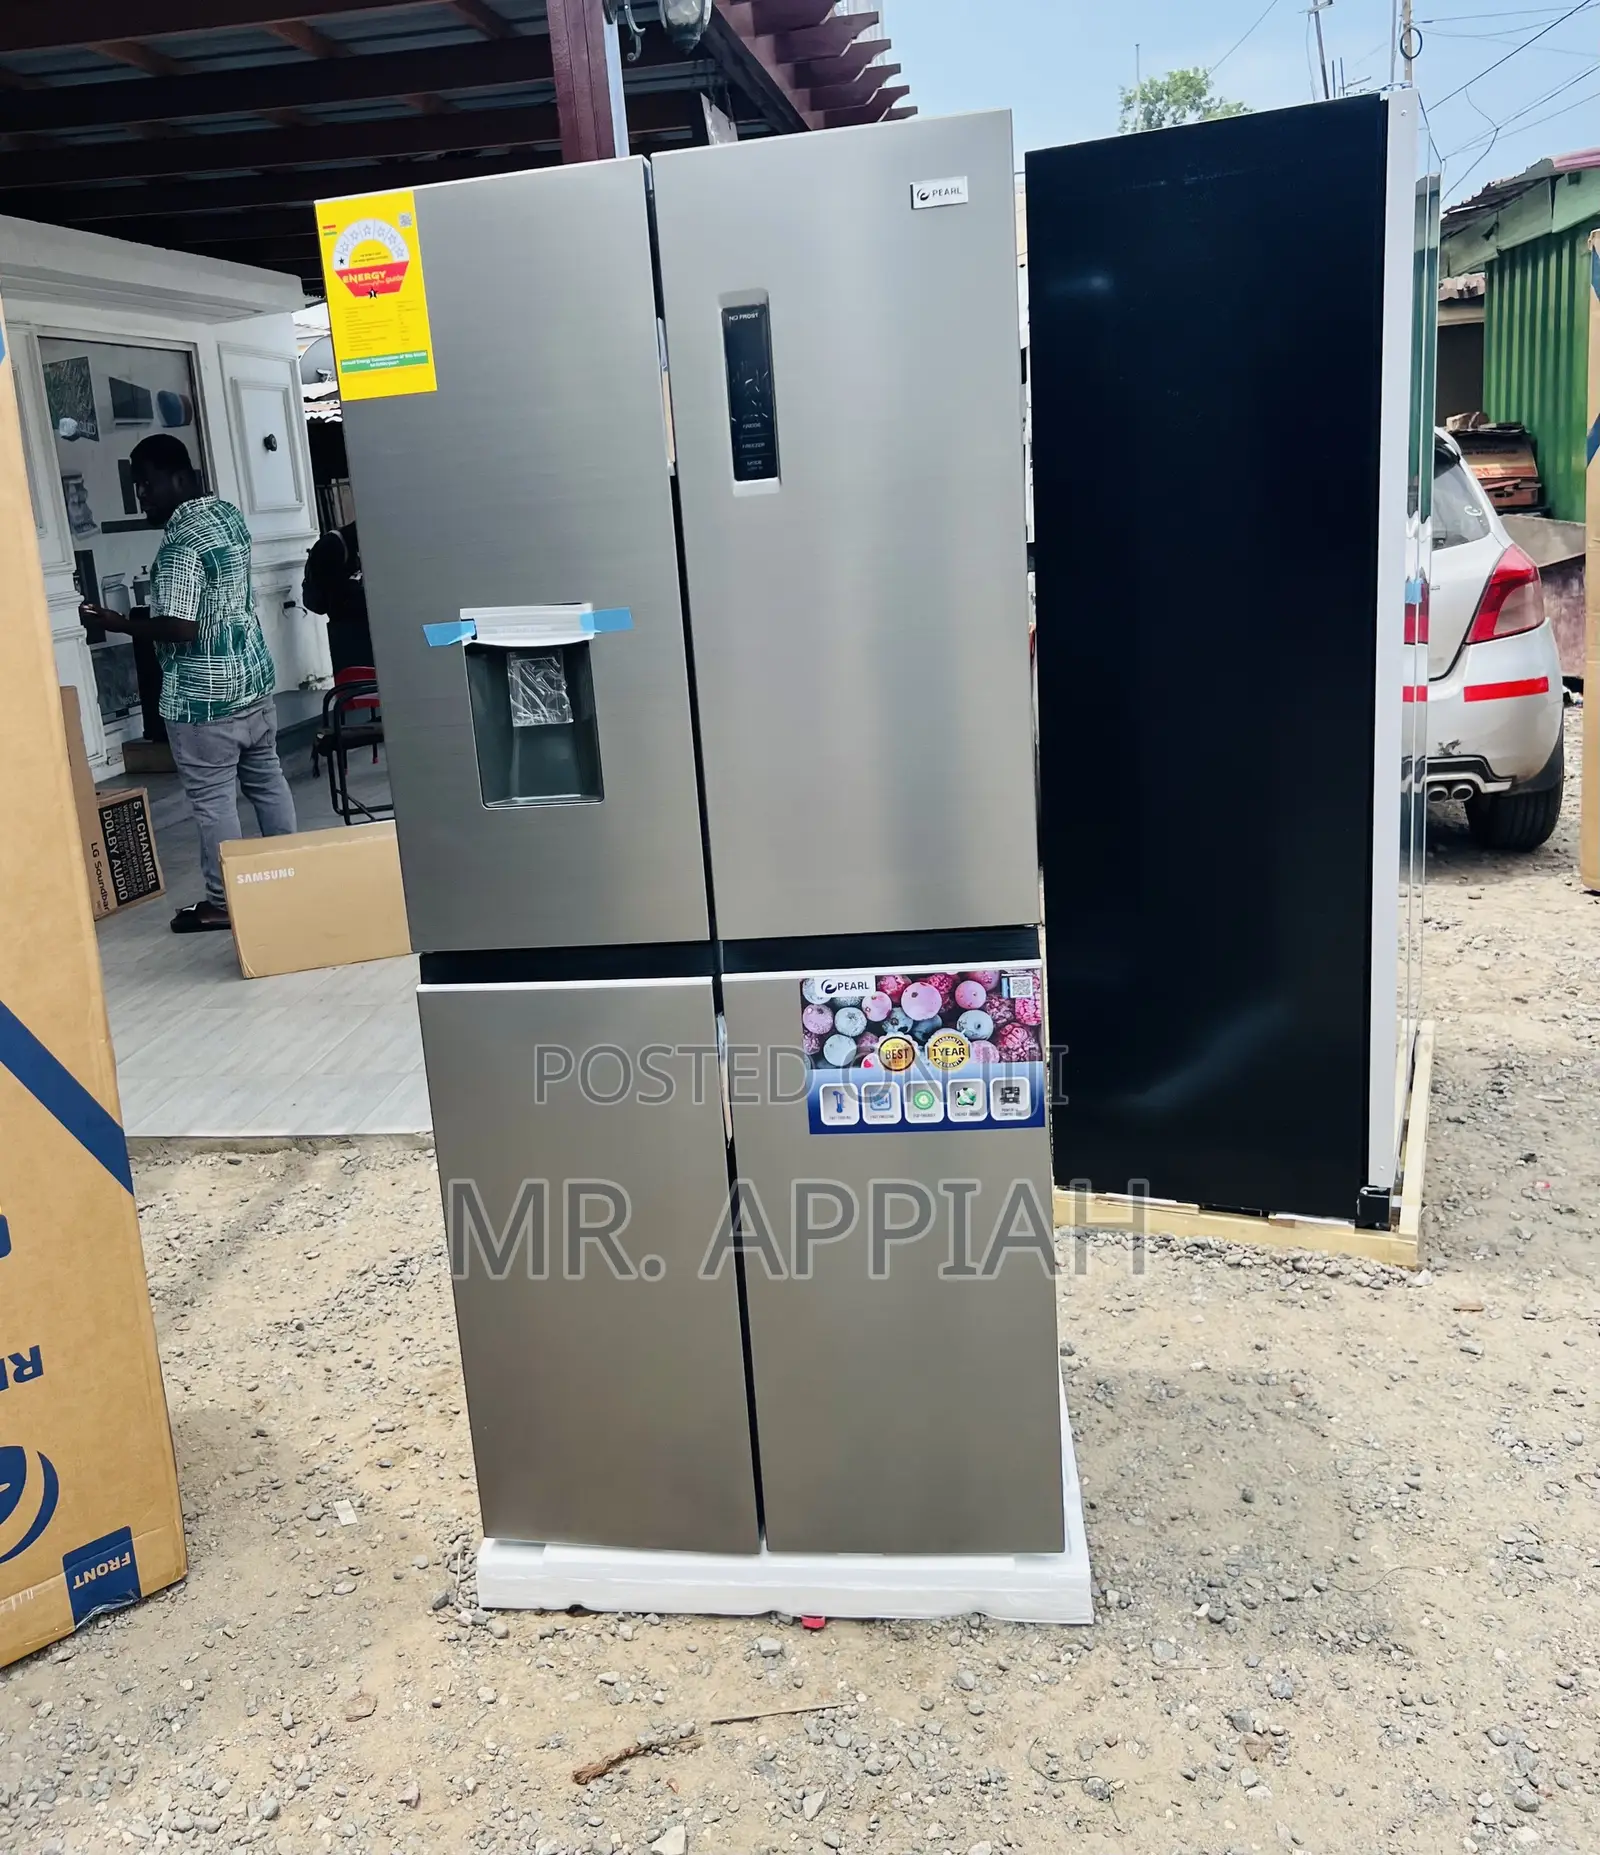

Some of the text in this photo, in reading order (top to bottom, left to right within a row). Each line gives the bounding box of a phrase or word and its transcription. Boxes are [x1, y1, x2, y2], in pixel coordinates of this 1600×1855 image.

[931, 187, 963, 197] PEARL
[740, 312, 759, 320] FROST
[90, 842, 100, 858] LG
[103, 809, 129, 900] DOLBY AUDIO
[236, 867, 295, 884] SAMSUNG
[94, 861, 110, 911] Soundbar
[837, 981, 869, 991] PEARL
[885, 1048, 909, 1060] BEST
[937, 1047, 965, 1057] YEAR
[73, 1551, 131, 1590] FRONT
